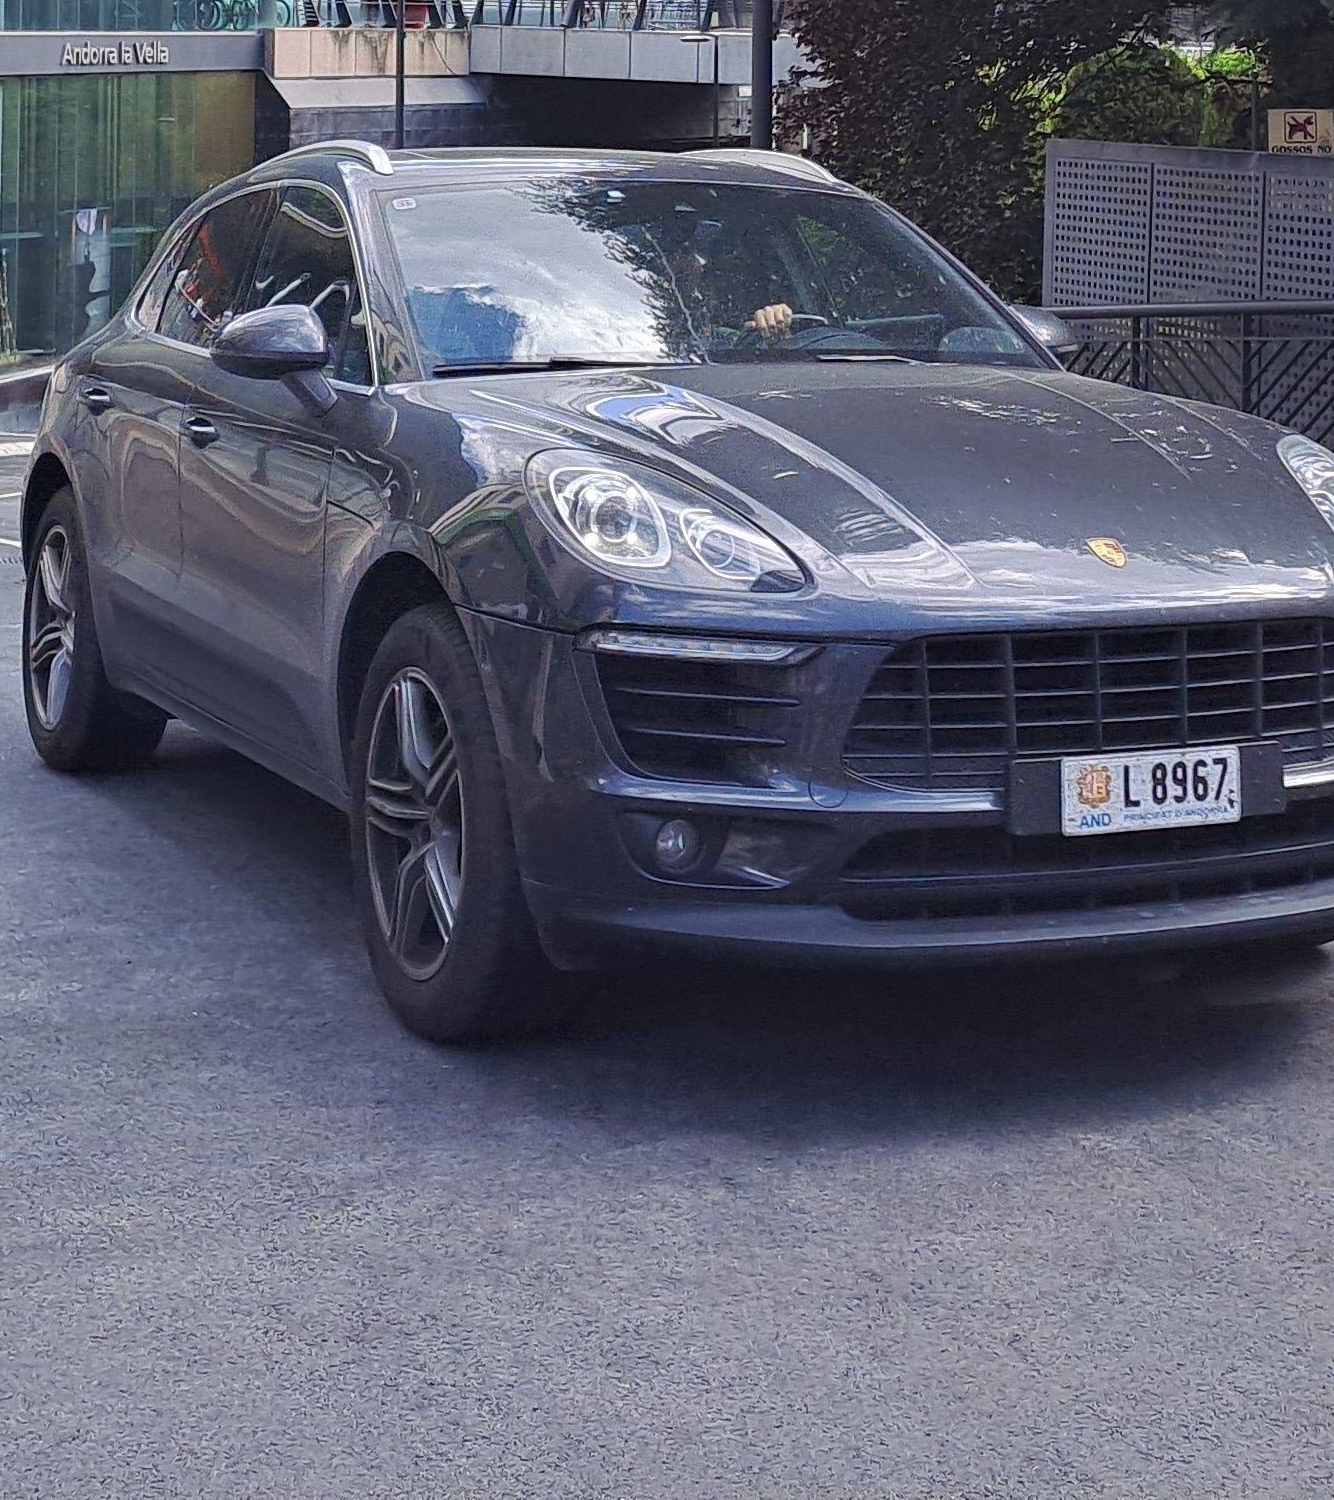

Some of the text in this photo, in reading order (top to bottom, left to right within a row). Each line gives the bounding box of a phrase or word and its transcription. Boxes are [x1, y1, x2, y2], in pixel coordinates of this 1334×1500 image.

[62, 40, 169, 65] Andorra la Vella
[1271, 145, 1332, 154] GOSSOS NO
[1123, 757, 1228, 808] L 8967
[1079, 813, 1112, 830] AND
